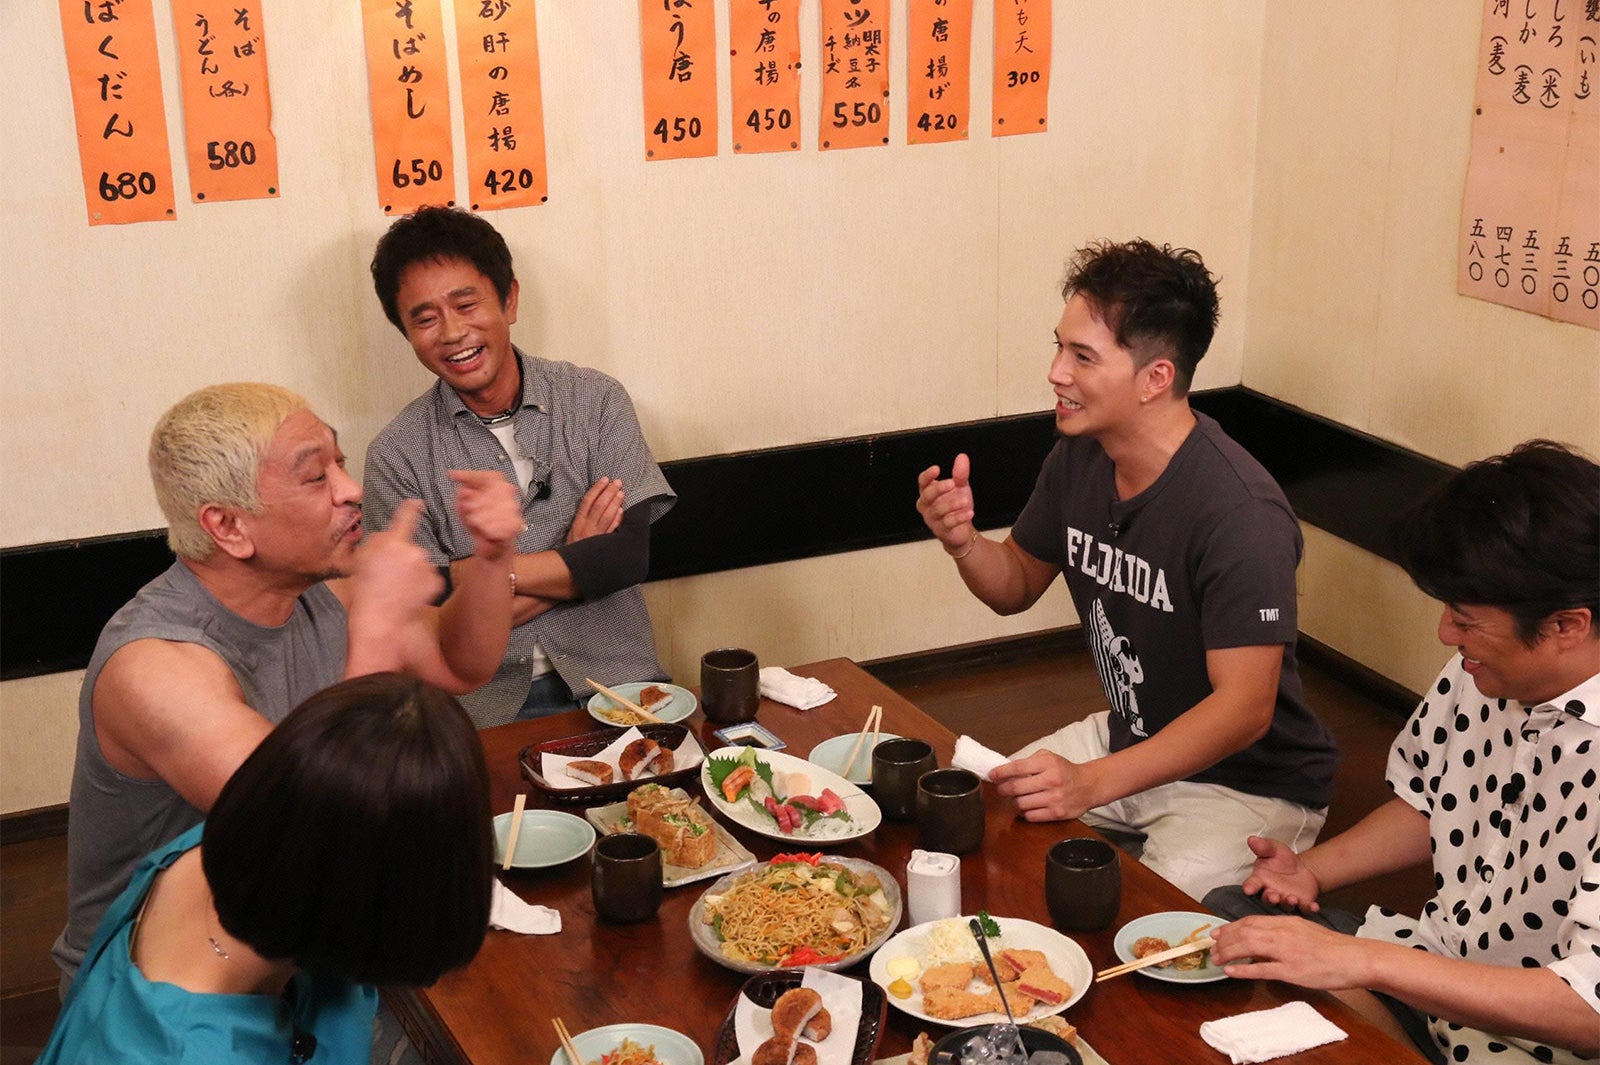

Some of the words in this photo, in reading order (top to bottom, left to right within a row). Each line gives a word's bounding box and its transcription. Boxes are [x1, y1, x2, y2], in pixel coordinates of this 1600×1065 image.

[195, 14, 218, 74] うどん
[234, 8, 259, 58] そば
[393, 0, 425, 119] そばめし
[825, 35, 840, 74] チーズ
[863, 30, 881, 73] 明太子
[85, 0, 133, 140] ばくだん
[479, 0, 516, 152] 砂肝の唐揚
[1008, 71, 1040, 88] 300
[746, 108, 791, 133] 450
[833, 102, 881, 128] 550
[917, 113, 957, 132] 420
[653, 117, 701, 143] 450
[207, 141, 256, 170] 580
[99, 172, 156, 201] 680
[393, 159, 442, 188] 650
[484, 168, 533, 195] 420
[1067, 526, 1174, 612] FLORIDA
[1259, 608, 1280, 621] TMT
